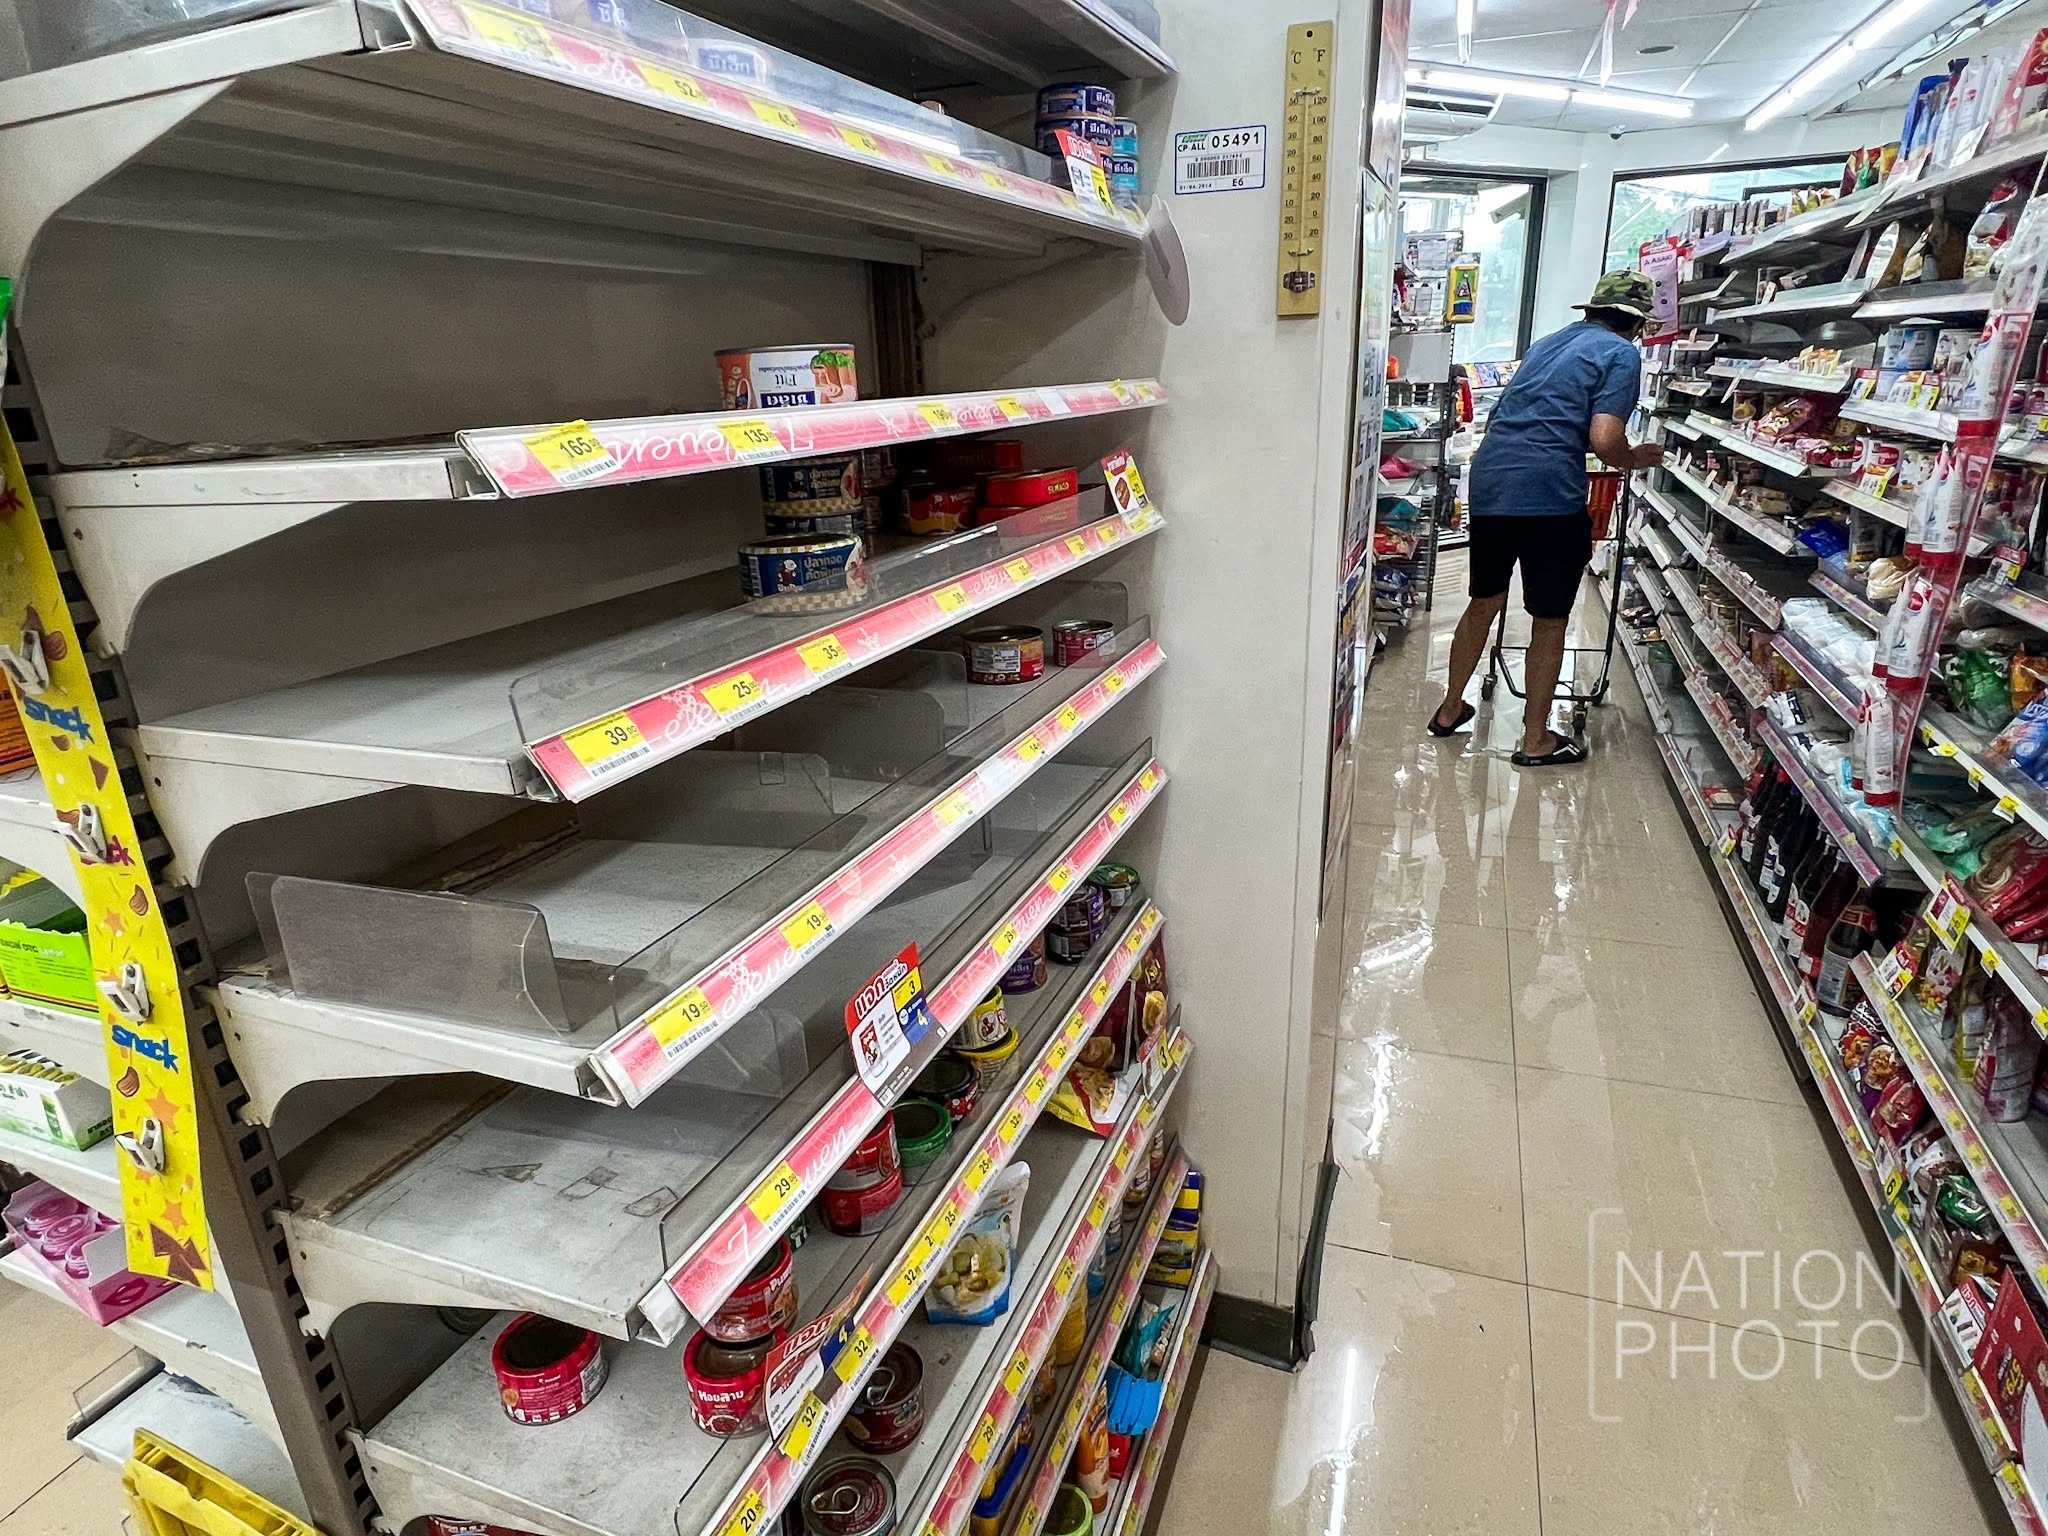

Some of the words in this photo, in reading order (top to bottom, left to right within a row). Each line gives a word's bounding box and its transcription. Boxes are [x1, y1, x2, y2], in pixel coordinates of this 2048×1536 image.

[1288, 98, 1299, 106] 50
[1313, 97, 1327, 105] 120
[1288, 114, 1298, 123] 40
[1312, 116, 1327, 125] 100
[1177, 144, 1188, 152] CP
[1191, 143, 1206, 151] ALL
[1211, 131, 1259, 149] 05491
[1312, 136, 1323, 144] 80
[1232, 178, 1244, 187] E6
[1311, 192, 1321, 200] 20
[744, 428, 769, 443] 135
[560, 437, 592, 458] 165
[823, 645, 839, 660] 35
[732, 681, 752, 698] 25
[24, 696, 95, 744] snack
[604, 726, 629, 746] 39
[807, 914, 822, 931] 19
[910, 980, 916, 996] 3
[682, 1003, 701, 1022] 19
[917, 1008, 928, 1026] 4
[112, 1025, 178, 1075] snack
[1011, 1113, 1020, 1124] 32
[979, 1160, 989, 1174] 25
[774, 1178, 791, 1198] 29
[945, 1211, 956, 1227] 25
[904, 1269, 917, 1286] 32
[838, 1324, 848, 1343] 4
[854, 1340, 869, 1358] 32
[698, 1389, 744, 1404] หอยลาย
[802, 1406, 817, 1428] 32
[983, 1425, 994, 1443] 29
[741, 1508, 757, 1533] 20
